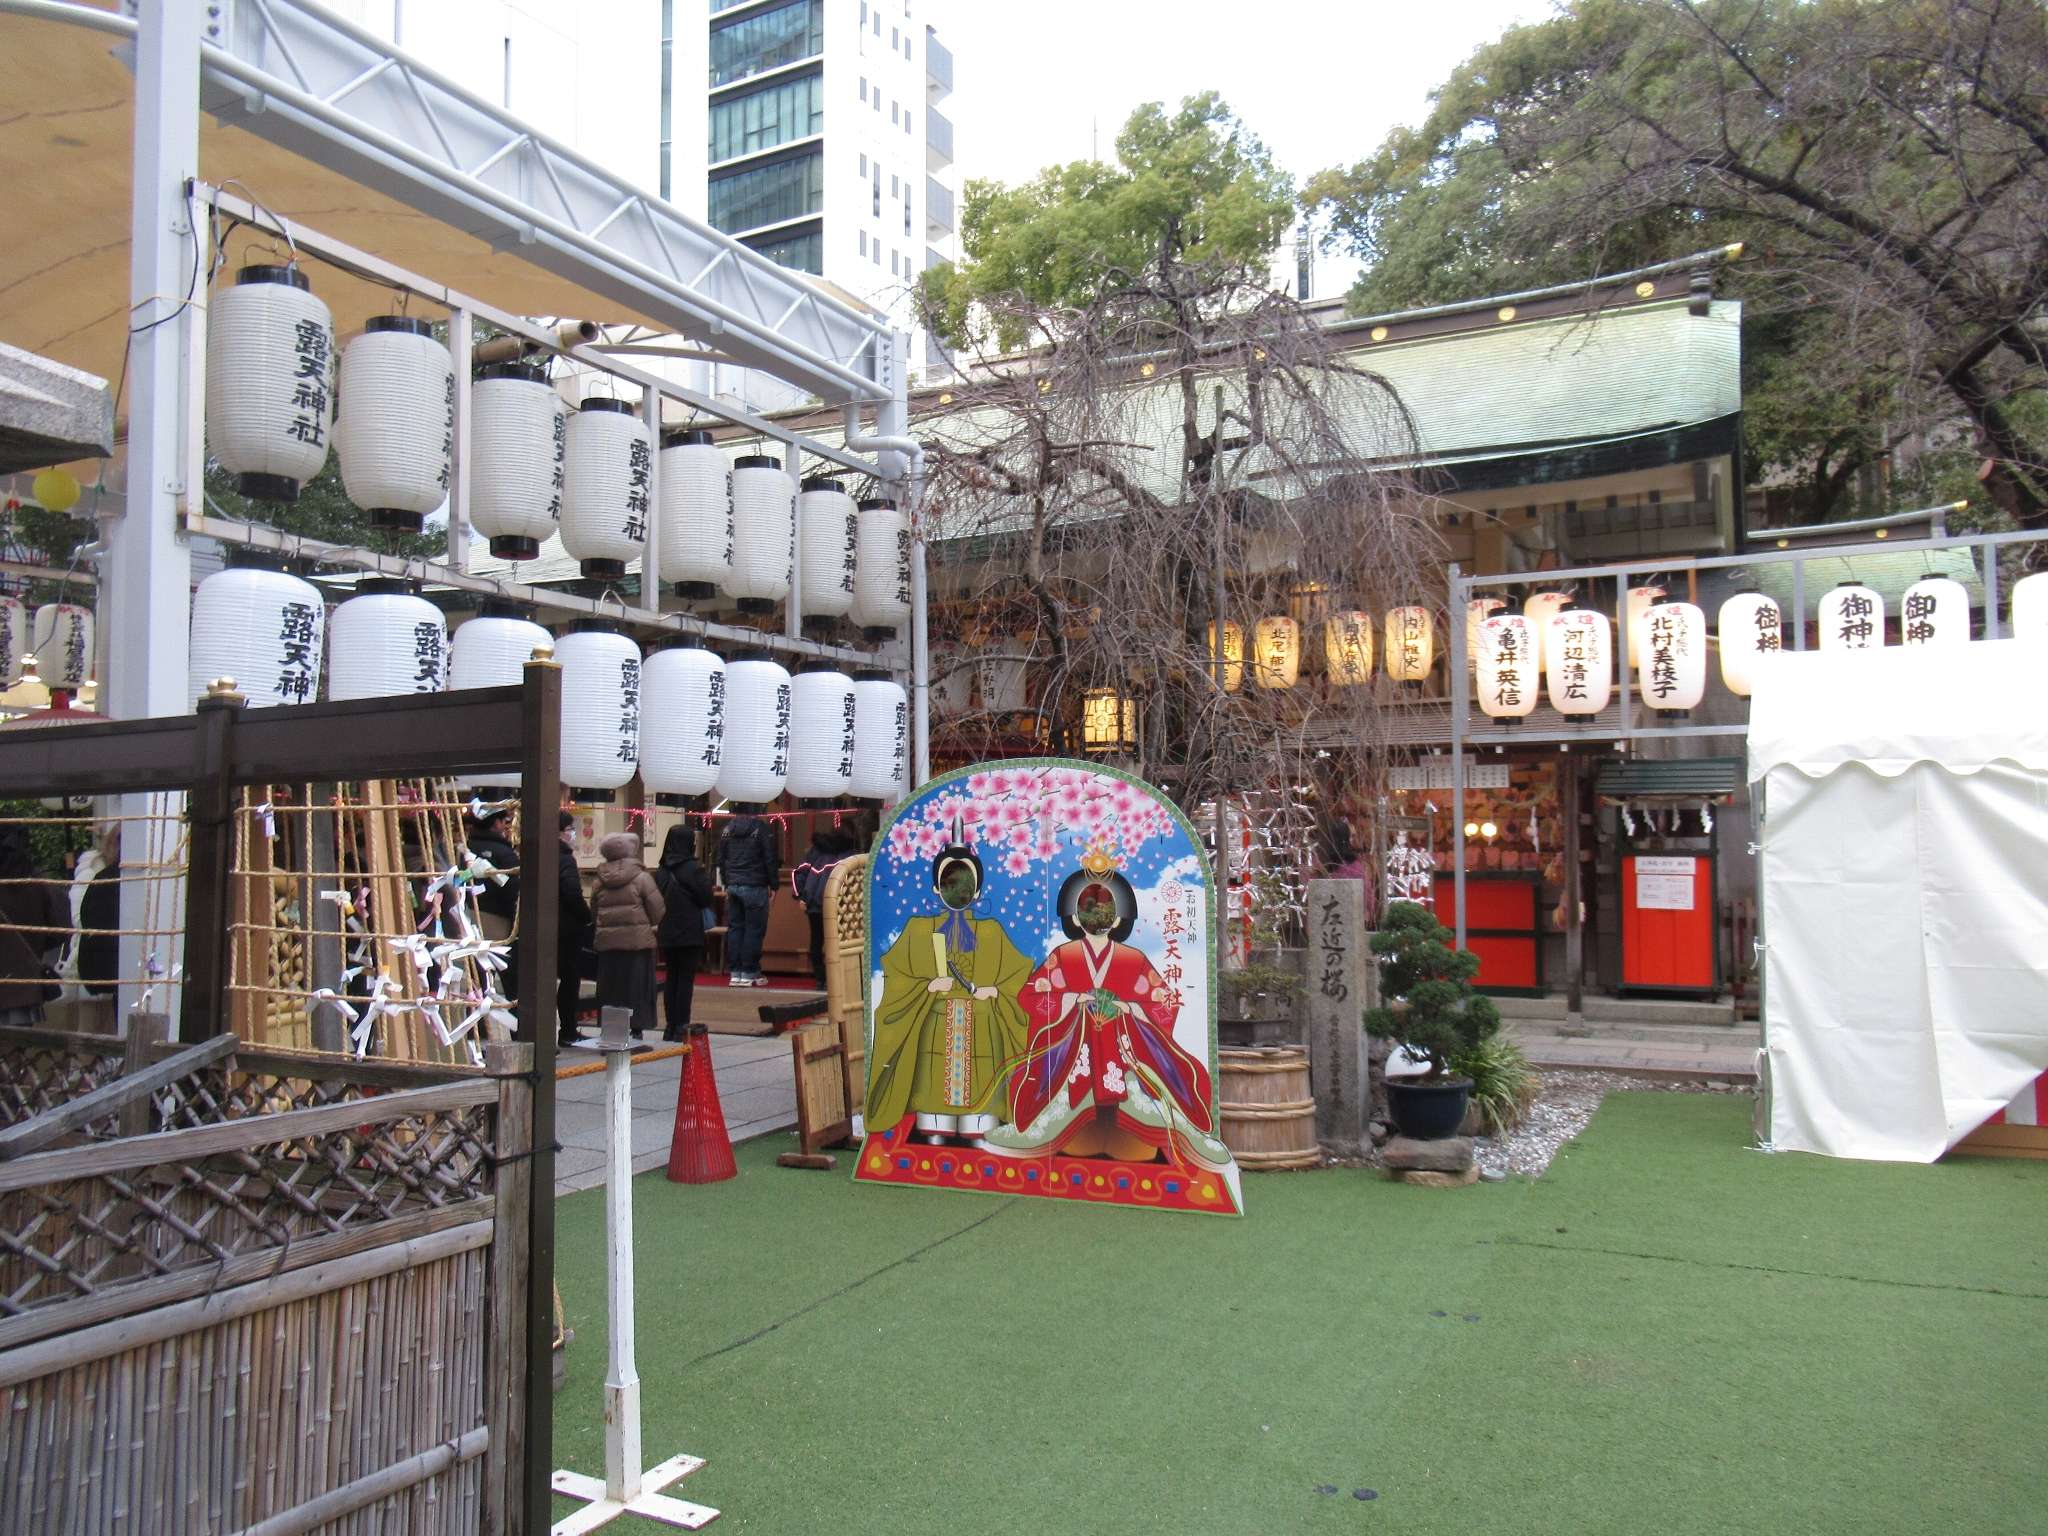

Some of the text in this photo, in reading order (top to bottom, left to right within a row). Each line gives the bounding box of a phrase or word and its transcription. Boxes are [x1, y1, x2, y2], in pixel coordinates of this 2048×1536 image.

[287, 319, 328, 448] 露天神社
[622, 438, 651, 542] 露天神社
[1563, 629, 1588, 700] 河辺清広
[1650, 617, 1679, 698] 北村美枝子
[1838, 594, 1873, 648] 御神
[617, 658, 640, 762] 露天神社
[1495, 627, 1521, 706] 亀井英信
[701, 671, 725, 765] 露天神社
[770, 685, 791, 776] 露天神社
[837, 693, 855, 777] 露天神社
[1163, 908, 1185, 1008] 露天神社
[1186, 892, 1197, 944] お初天神
